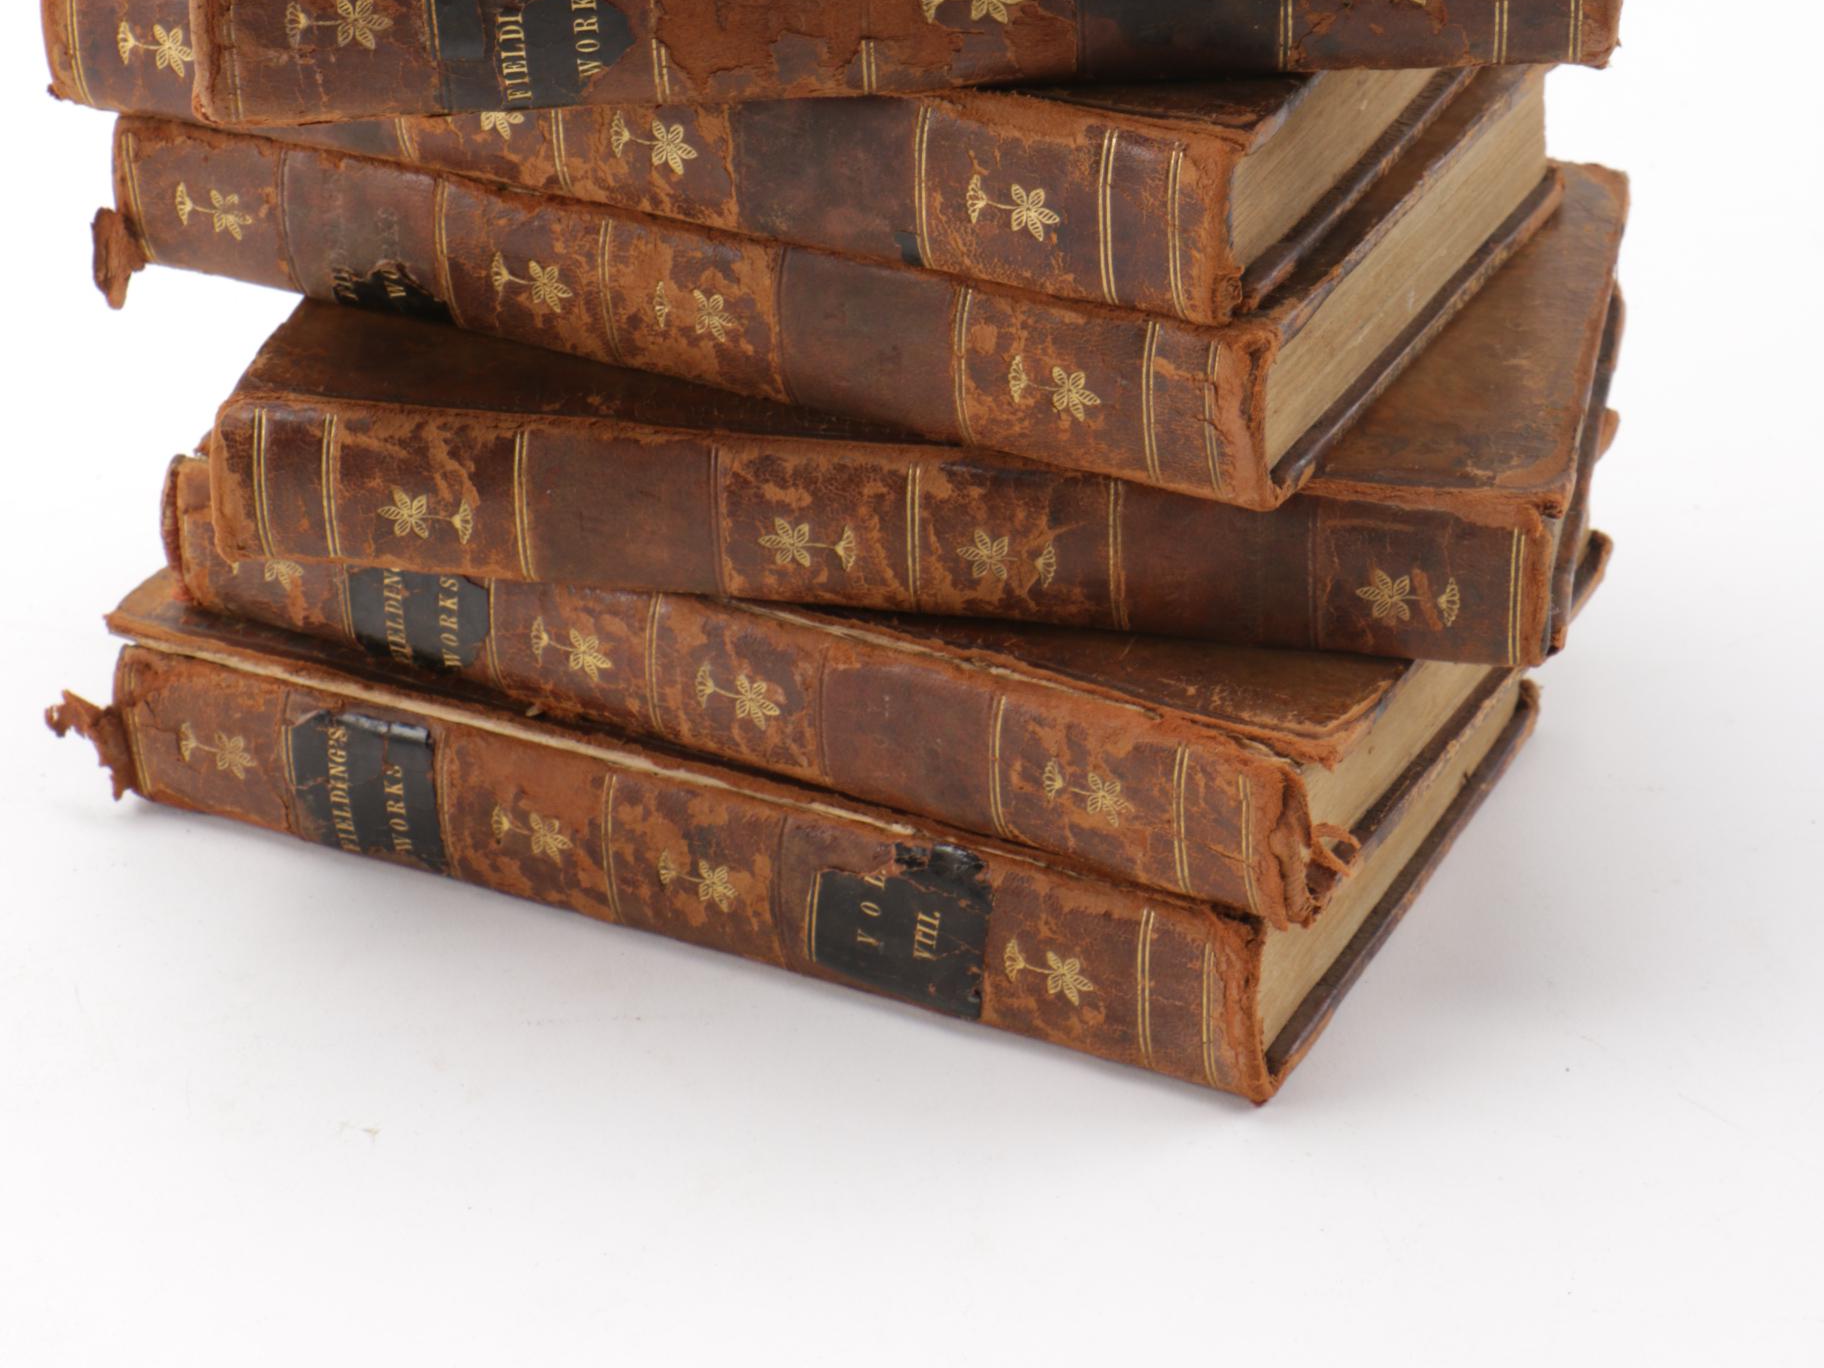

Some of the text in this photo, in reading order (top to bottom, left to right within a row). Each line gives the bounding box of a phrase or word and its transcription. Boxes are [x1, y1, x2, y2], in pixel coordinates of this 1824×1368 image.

[438, 574, 464, 668] WORKS
[327, 726, 362, 853] FIELDING'S
[383, 764, 413, 852] WORKS
